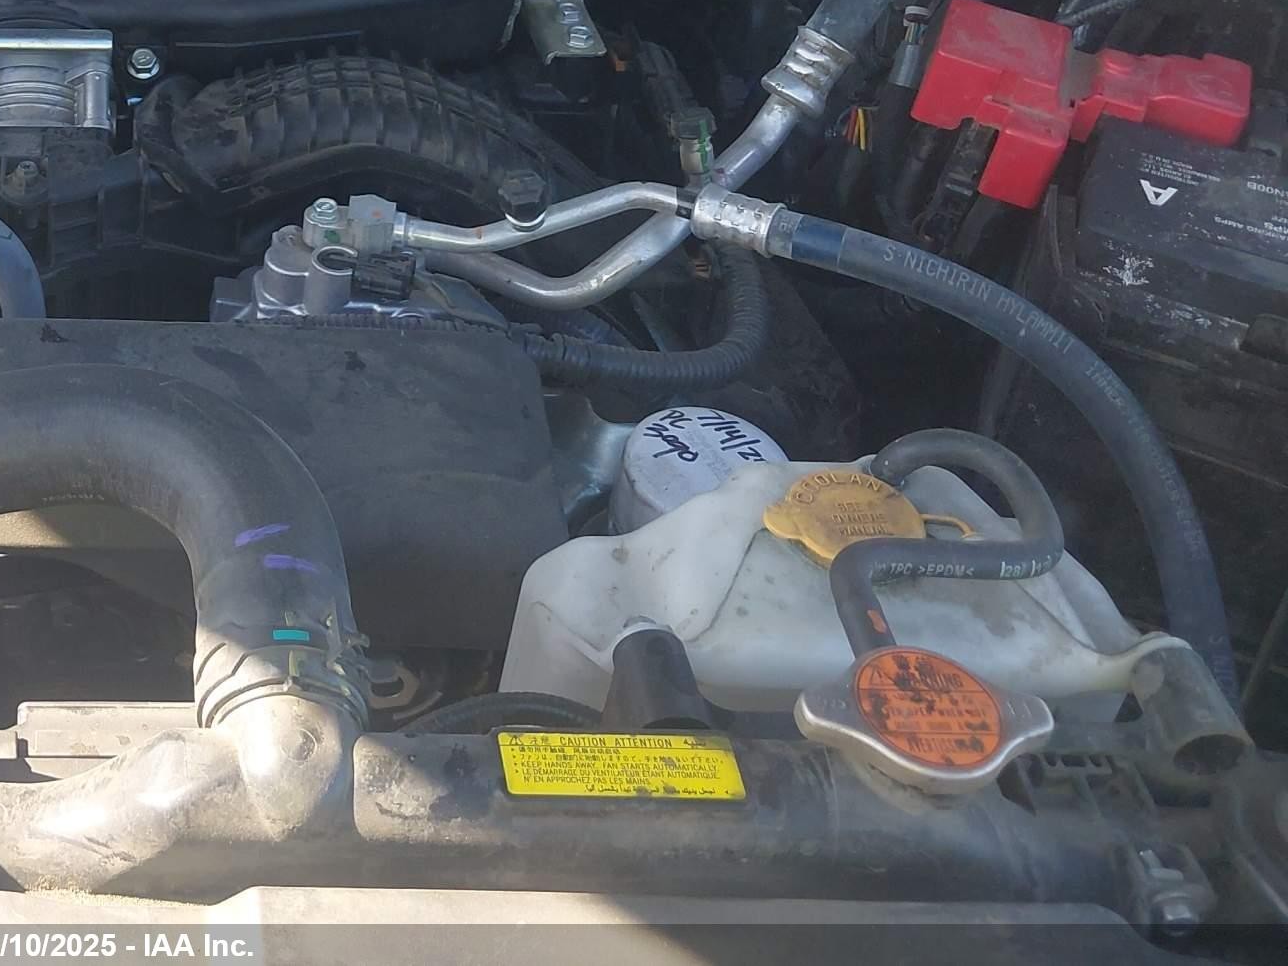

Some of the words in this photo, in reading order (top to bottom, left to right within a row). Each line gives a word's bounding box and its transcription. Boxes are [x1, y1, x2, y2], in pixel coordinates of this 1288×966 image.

[560, 737, 606, 747] CAUTION
[614, 737, 672, 747] ATTENTION
[544, 761, 572, 769] HANDS
